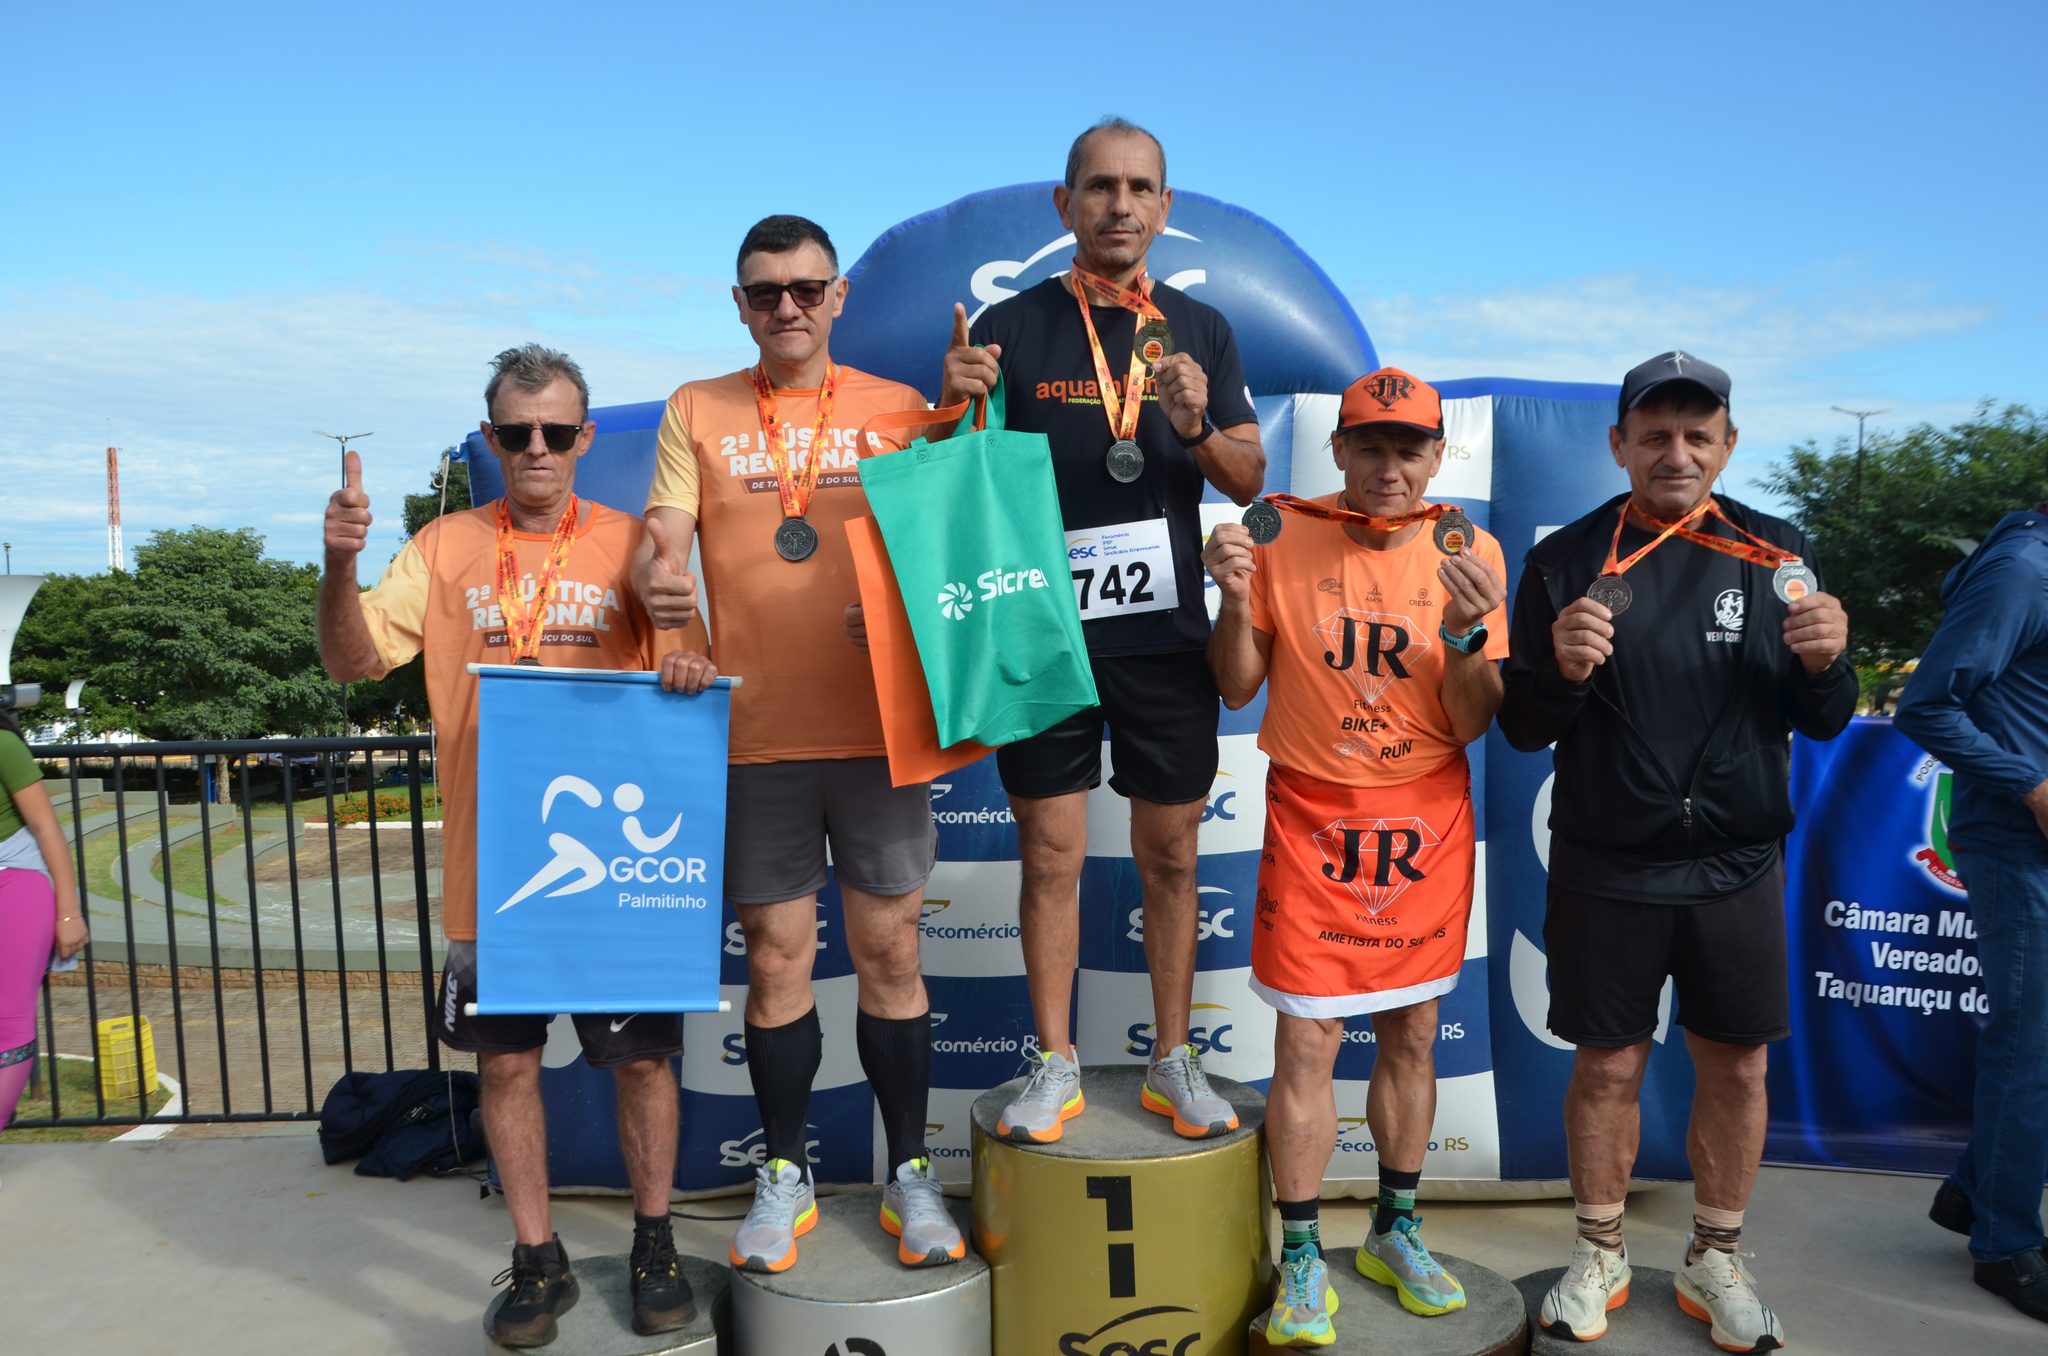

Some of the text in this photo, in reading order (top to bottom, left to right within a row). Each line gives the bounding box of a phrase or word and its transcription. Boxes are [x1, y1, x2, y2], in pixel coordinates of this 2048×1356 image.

[1372, 376, 1411, 400] JR
[720, 422, 883, 456] 2ª ÚSICA
[1448, 445, 1471, 460] RS
[1068, 546, 1098, 559] esc
[465, 573, 620, 611] 2ª ÚTICA
[977, 567, 1049, 602] Sicre
[1071, 561, 1155, 610] 742
[489, 635, 501, 643] DE
[560, 634, 574, 642] DO
[576, 635, 593, 643] SUL
[1324, 616, 1412, 679] JR
[1705, 631, 1723, 641] VEM
[1354, 700, 1392, 713] Fitness
[1380, 740, 1413, 759] RUN
[609, 856, 706, 883] GCOR
[1322, 828, 1425, 886] JR
[618, 893, 707, 909] Palmitinho
[1126, 908, 1234, 942] Ssc
[1824, 900, 1930, 935] Câmara
[1318, 930, 1380, 947] AMETISTA
[1385, 938, 1404, 948] DO
[1433, 928, 1447, 939] RS
[1815, 971, 1952, 1016] Taquaruçu
[1124, 1022, 1232, 1057] Ssc
[1442, 1023, 1465, 1040] RS
[1445, 1137, 1469, 1151] RS
